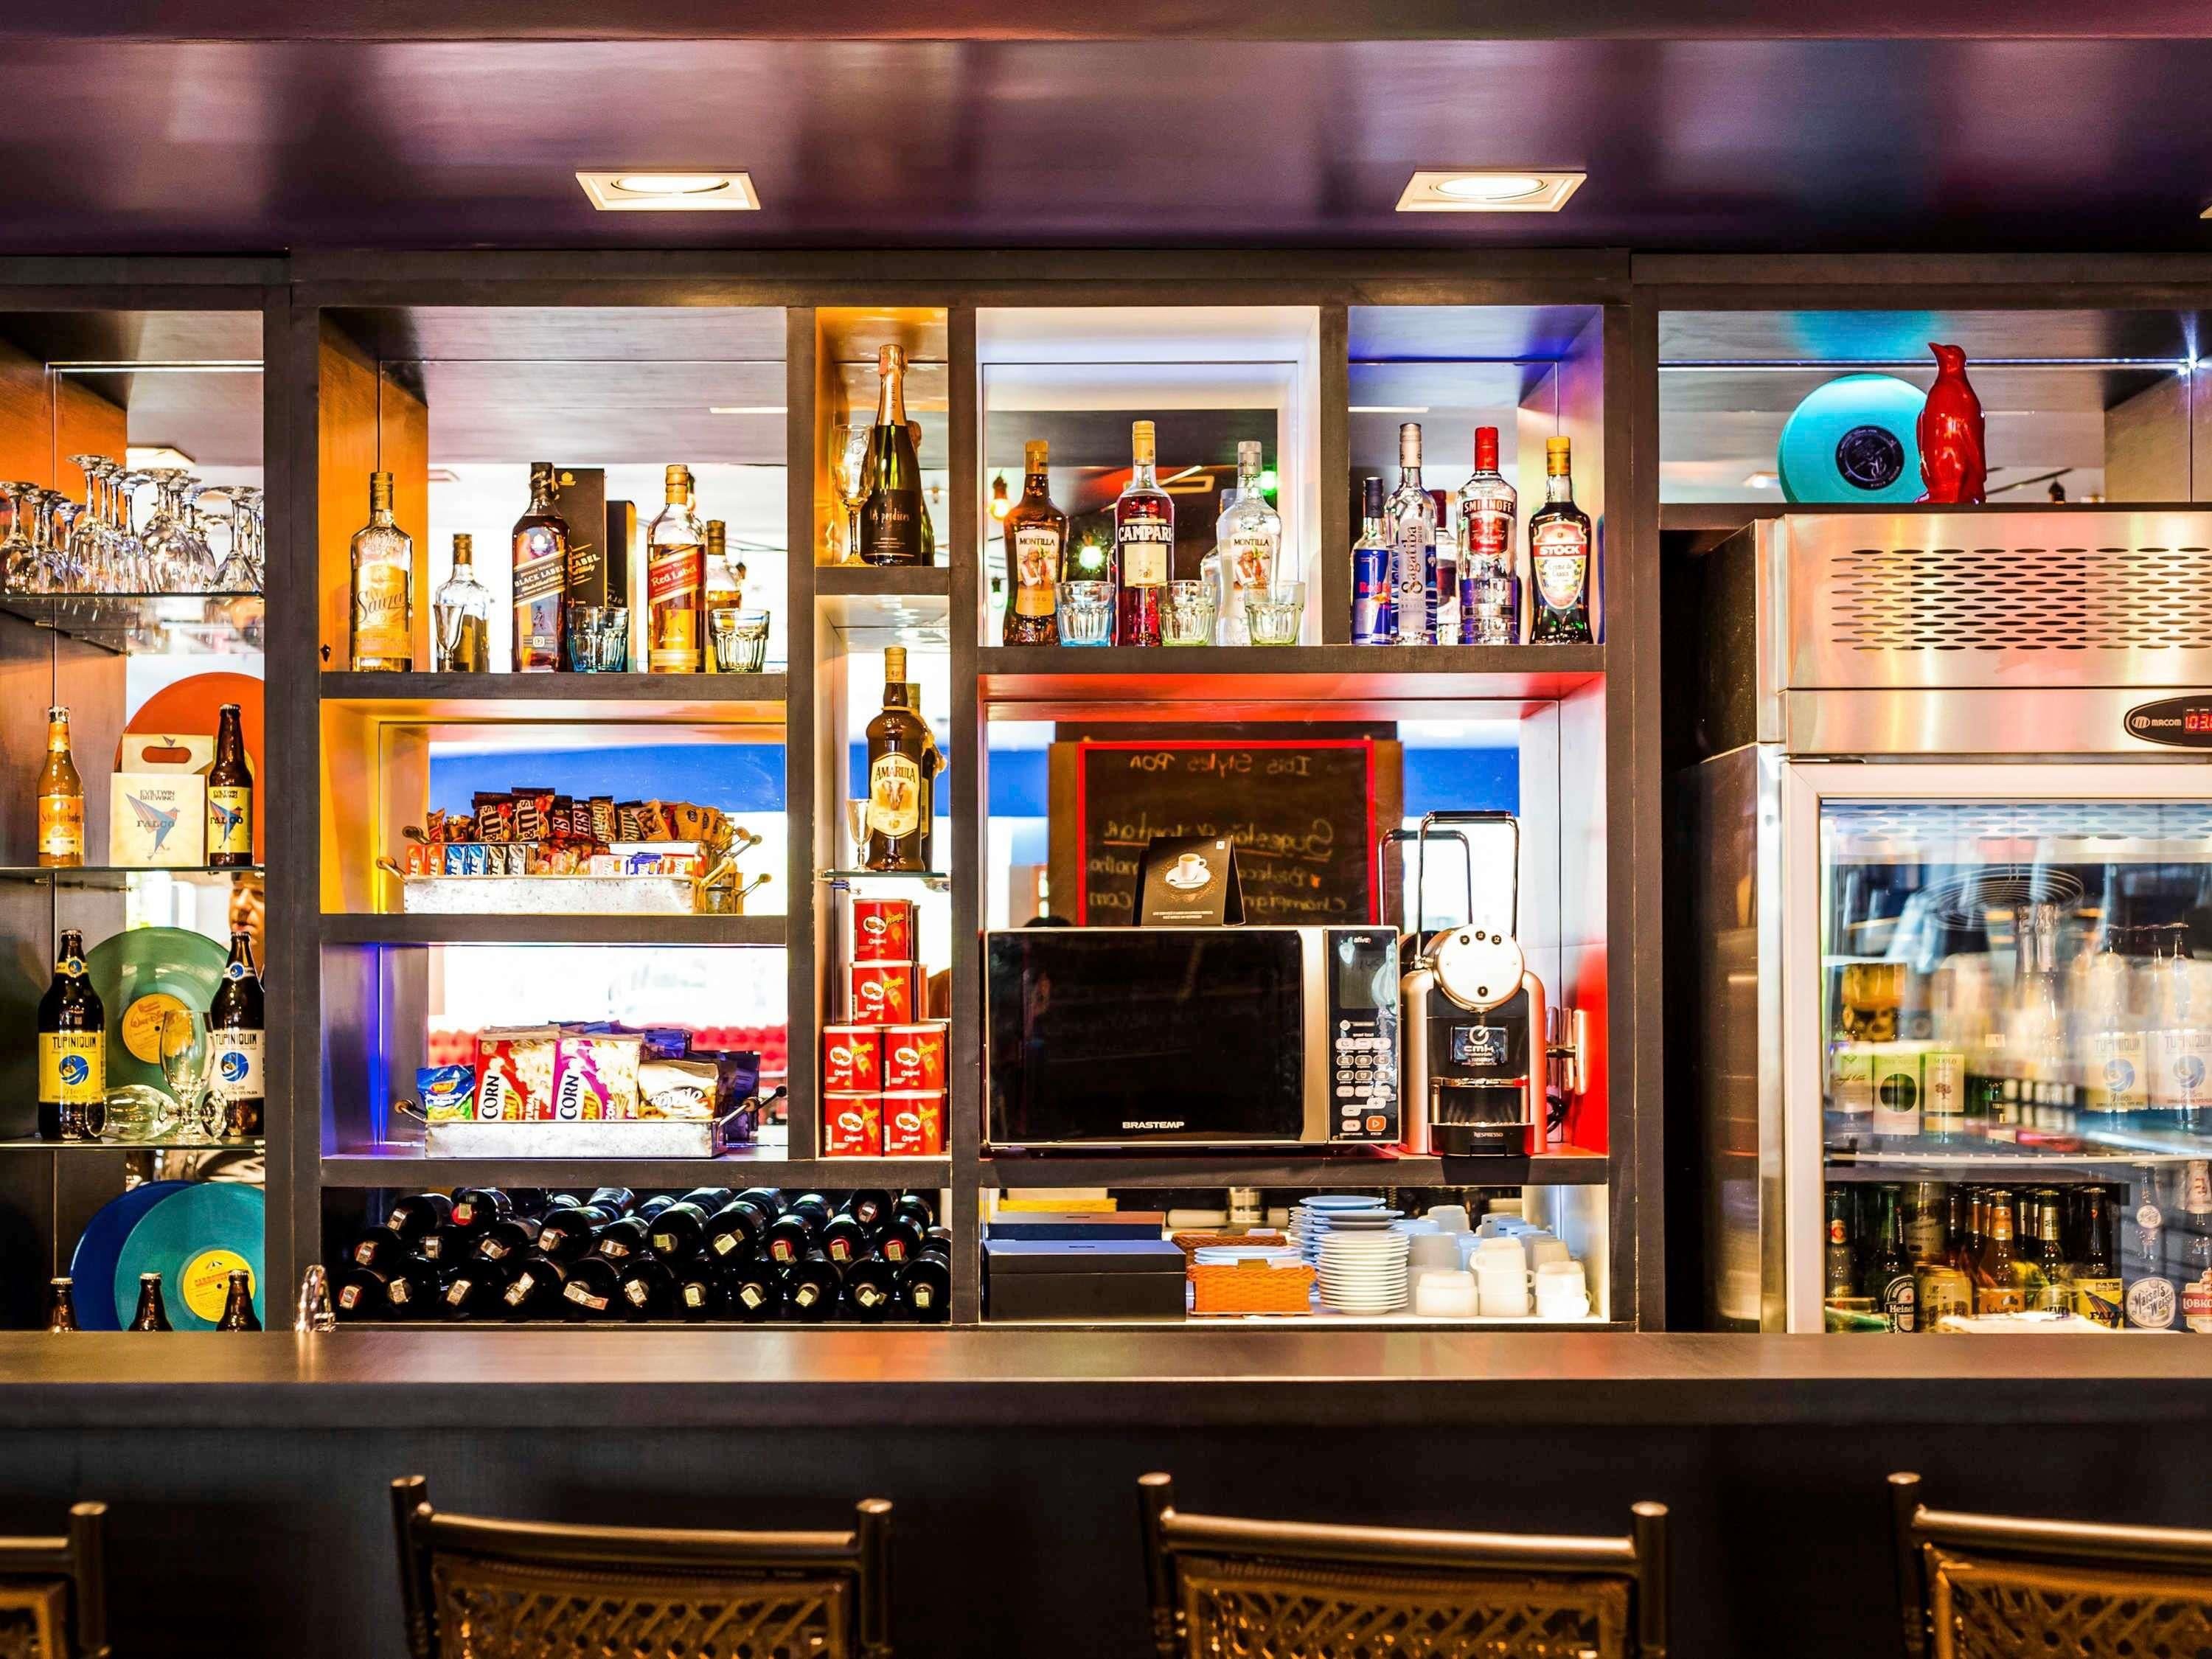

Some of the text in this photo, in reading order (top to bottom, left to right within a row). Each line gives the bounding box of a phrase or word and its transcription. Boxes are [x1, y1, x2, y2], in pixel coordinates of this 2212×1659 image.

[1464, 499, 1513, 513] SMIRNOFF
[1118, 525, 1172, 543] CAMPARI
[1019, 537, 1055, 546] MONTILLA
[1234, 538, 1270, 546] MONTILLA
[1539, 546, 1581, 555] STOCK
[574, 554, 601, 568] ABEL
[1401, 526, 1423, 594] Sagatiba
[514, 574, 539, 587] BLACK
[541, 566, 566, 577] LABEL
[651, 564, 697, 587] Red Label
[874, 766, 916, 783] AMARULA
[210, 815, 243, 824] FALCO
[52, 1036, 97, 1048] TUPINIQUIM
[215, 1033, 257, 1045] TUPINIQUIM
[481, 1074, 501, 1120] CORN
[560, 1074, 580, 1120] CORN
[504, 1096, 518, 1120] OKI
[1889, 1304, 1914, 1314] Heine
